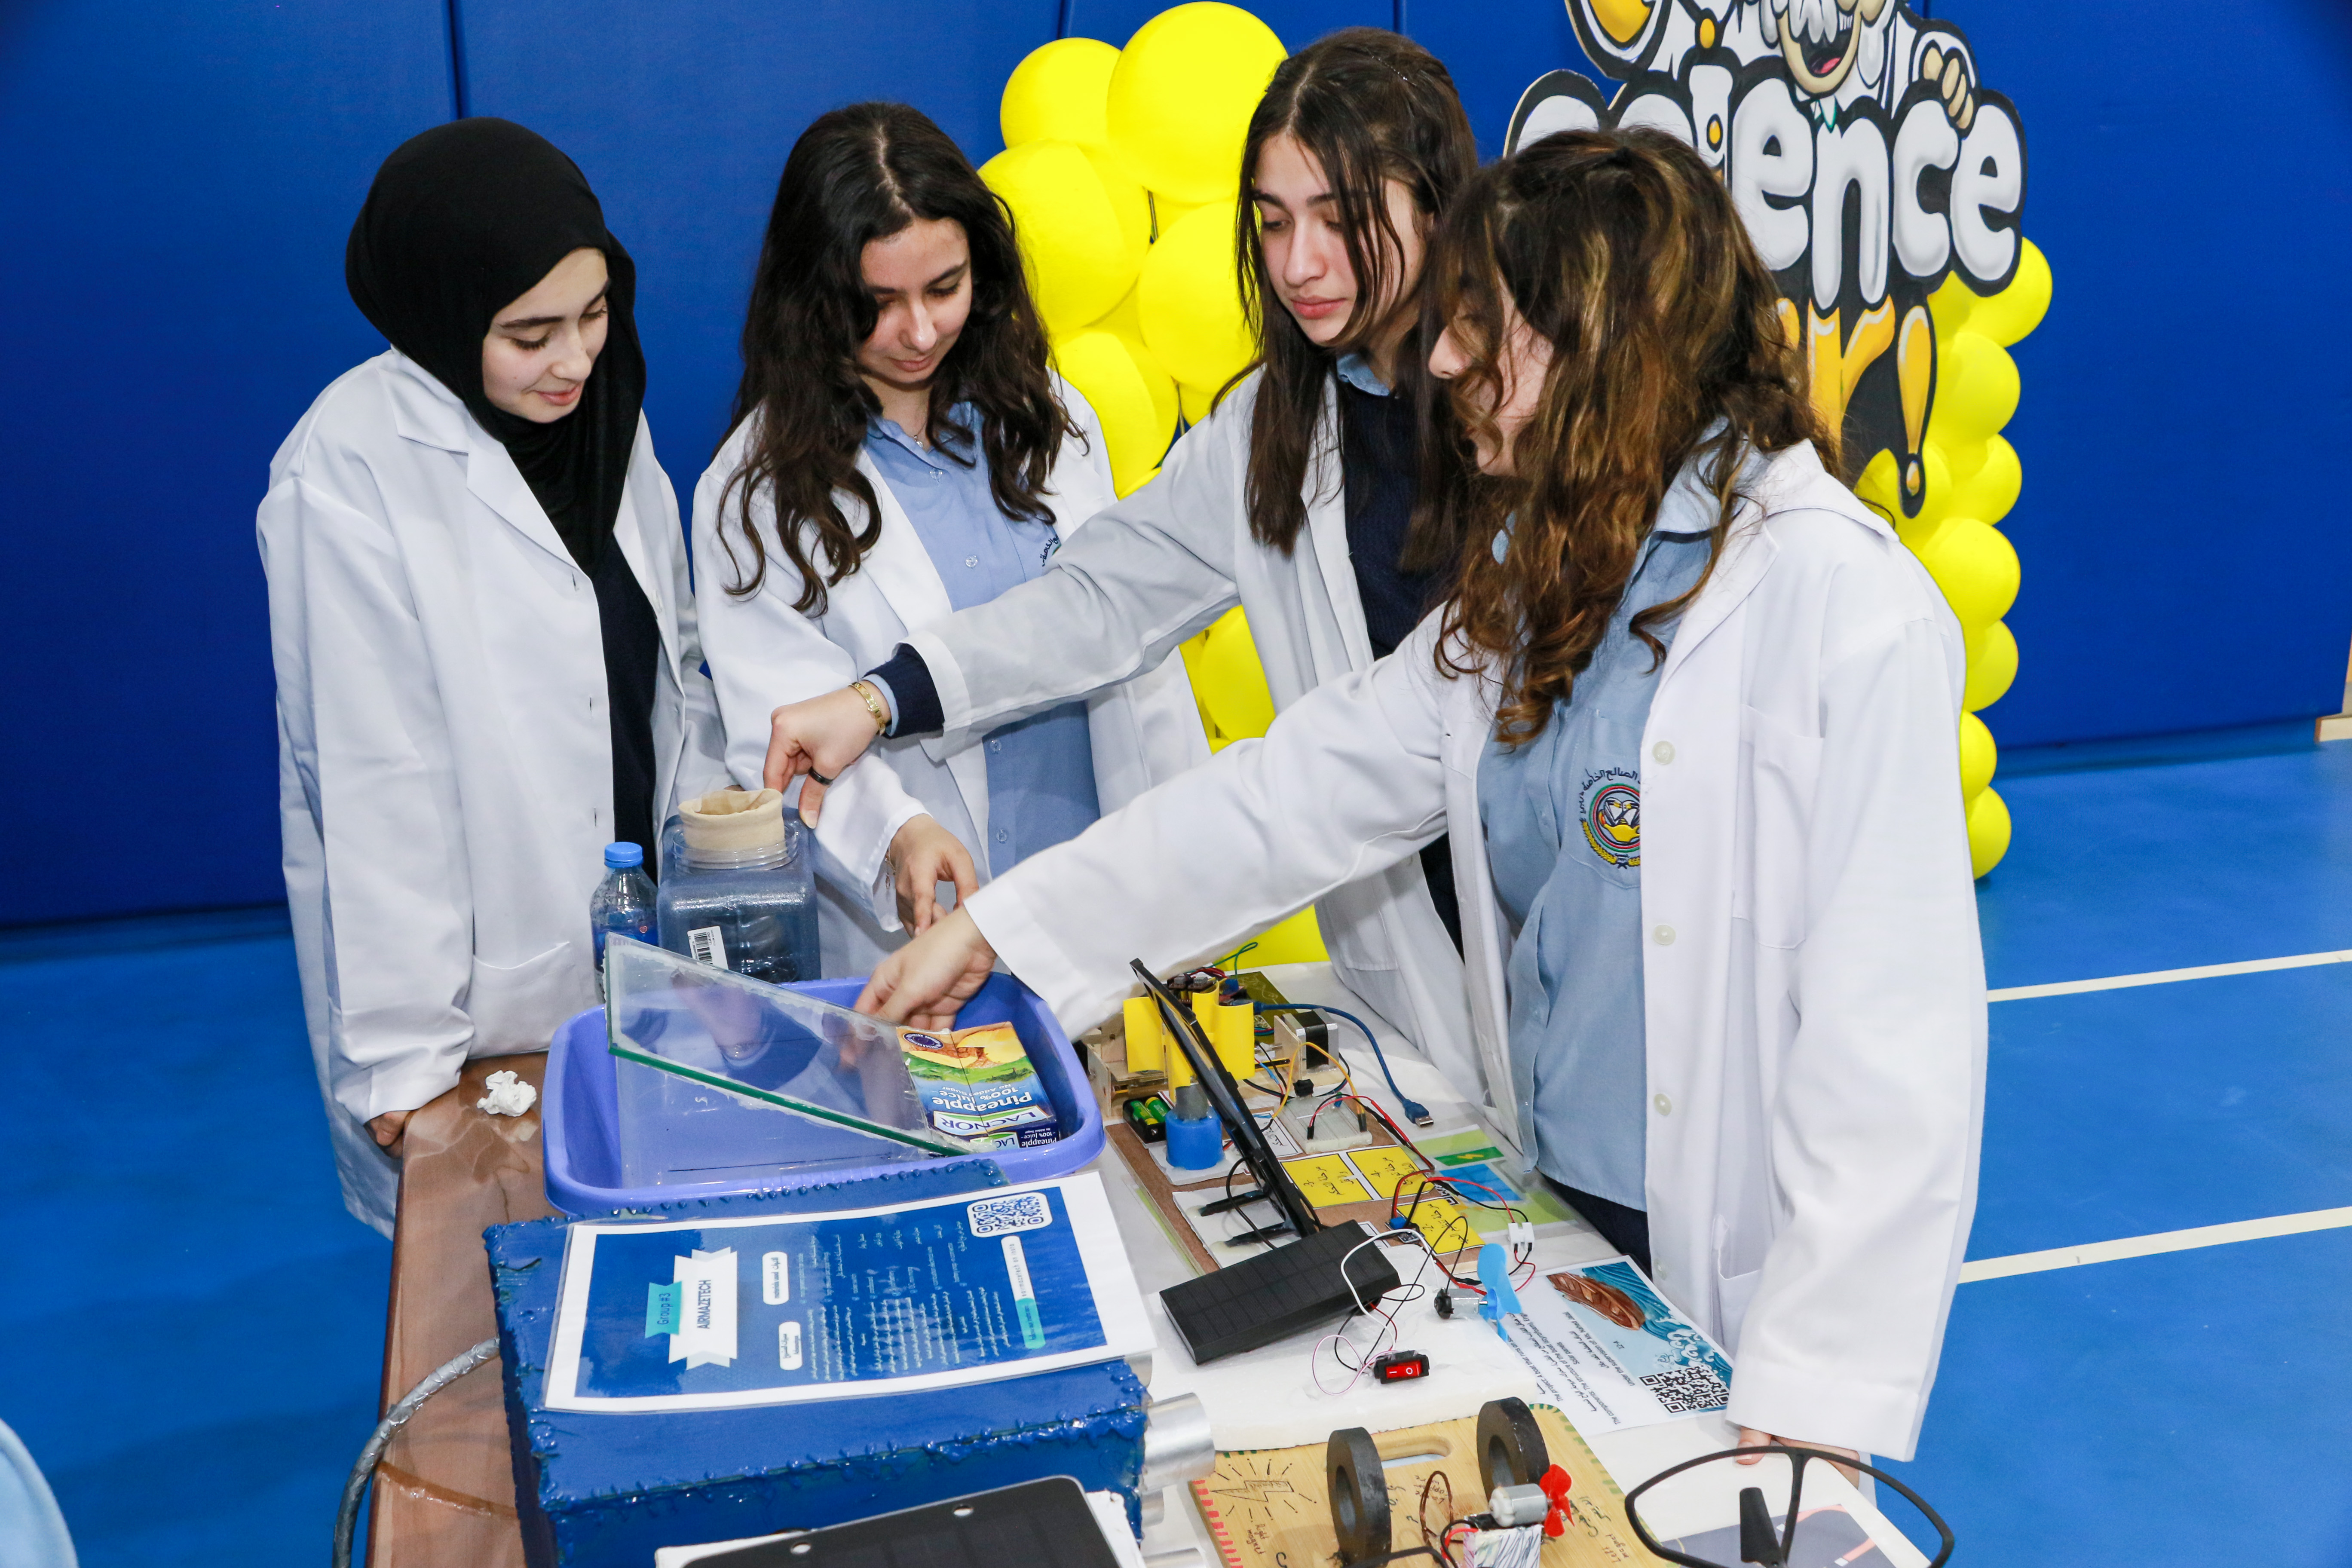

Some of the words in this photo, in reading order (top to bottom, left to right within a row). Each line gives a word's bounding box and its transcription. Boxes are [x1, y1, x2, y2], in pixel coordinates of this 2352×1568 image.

[940, 1091, 975, 1104] Juice
[980, 1087, 1019, 1100] 100%
[932, 1091, 1032, 1112] Pineapple
[940, 1112, 1036, 1130] LACNOR
[1021, 1137, 1057, 1148] Pineapple
[1316, 1166, 1328, 1181] مرحلة
[658, 1293, 671, 1302] #3
[696, 1279, 711, 1329] AIRMAZETECH
[657, 1303, 674, 1325] Group
[1570, 1320, 1586, 1333] Nahed
[1515, 1348, 1525, 1357] runs
[1546, 1343, 1558, 1353] boat
[1556, 1341, 1571, 1354] panels
[1522, 1356, 1532, 1365] that
[1567, 1354, 1580, 1365] Solar
[1594, 1344, 1617, 1366] supervision
[1529, 1365, 1540, 1375] boat
[1565, 1364, 1584, 1382] structure
[1580, 1382, 1590, 1390] The
[1620, 1374, 1635, 1386] Under
[1554, 1393, 1563, 1402] The
[1611, 1416, 1620, 1425] The
